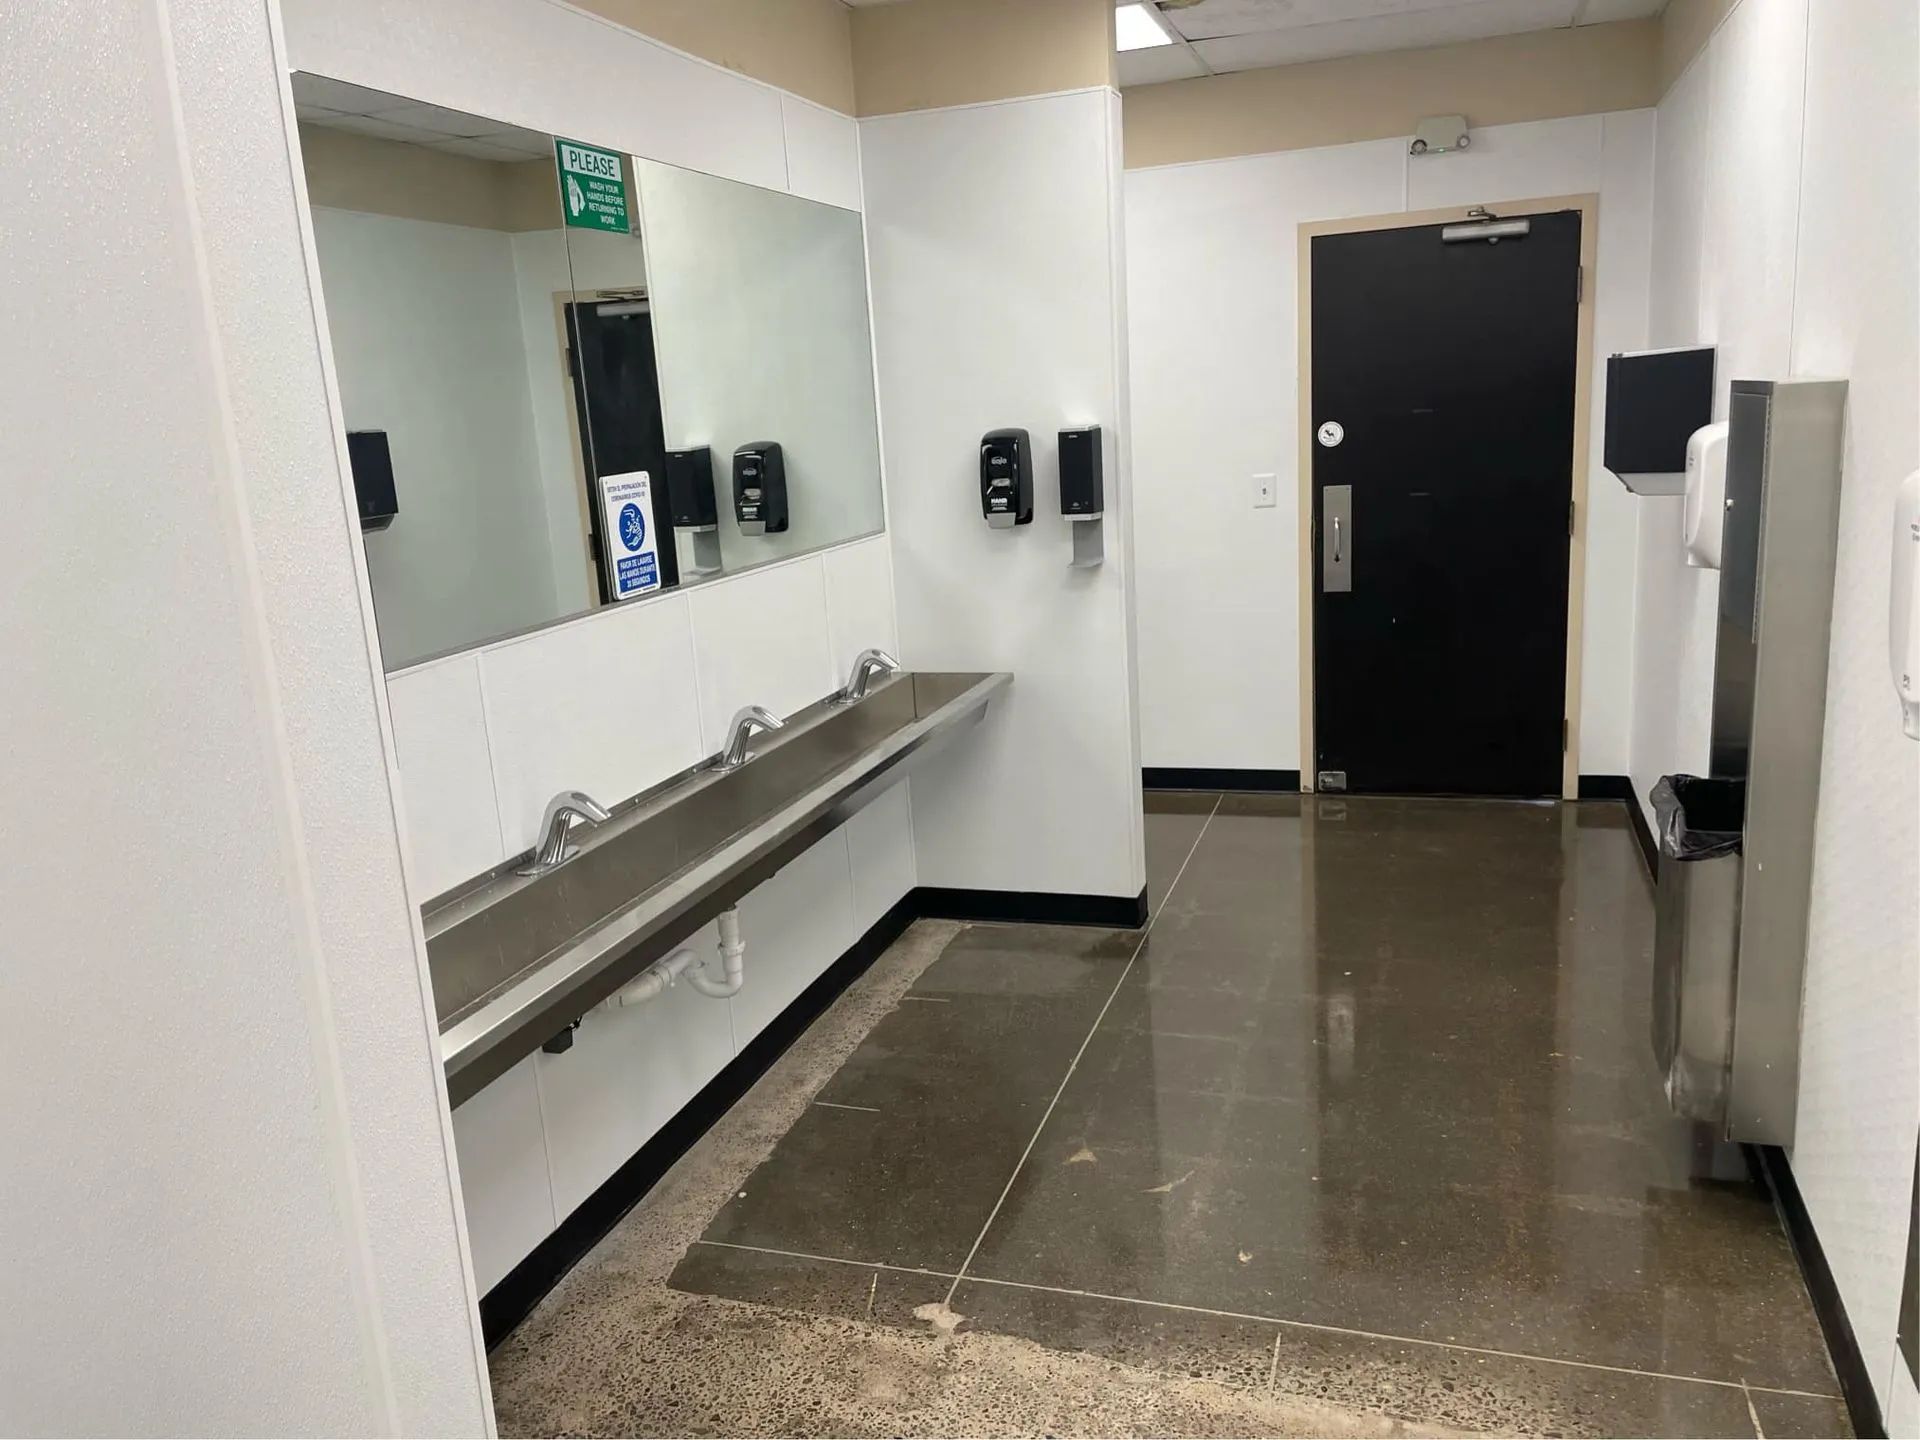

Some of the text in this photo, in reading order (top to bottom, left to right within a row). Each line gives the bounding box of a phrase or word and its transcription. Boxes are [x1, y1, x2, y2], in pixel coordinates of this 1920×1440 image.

[570, 150, 615, 177] PLEASE
[589, 181, 619, 194] WASH YOUR
[586, 191, 624, 205] HANDS BEFORE
[588, 202, 624, 216] RETURNING TO
[600, 215, 616, 225] WORK
[620, 559, 632, 569] FAVOR
[631, 558, 637, 568] DE
